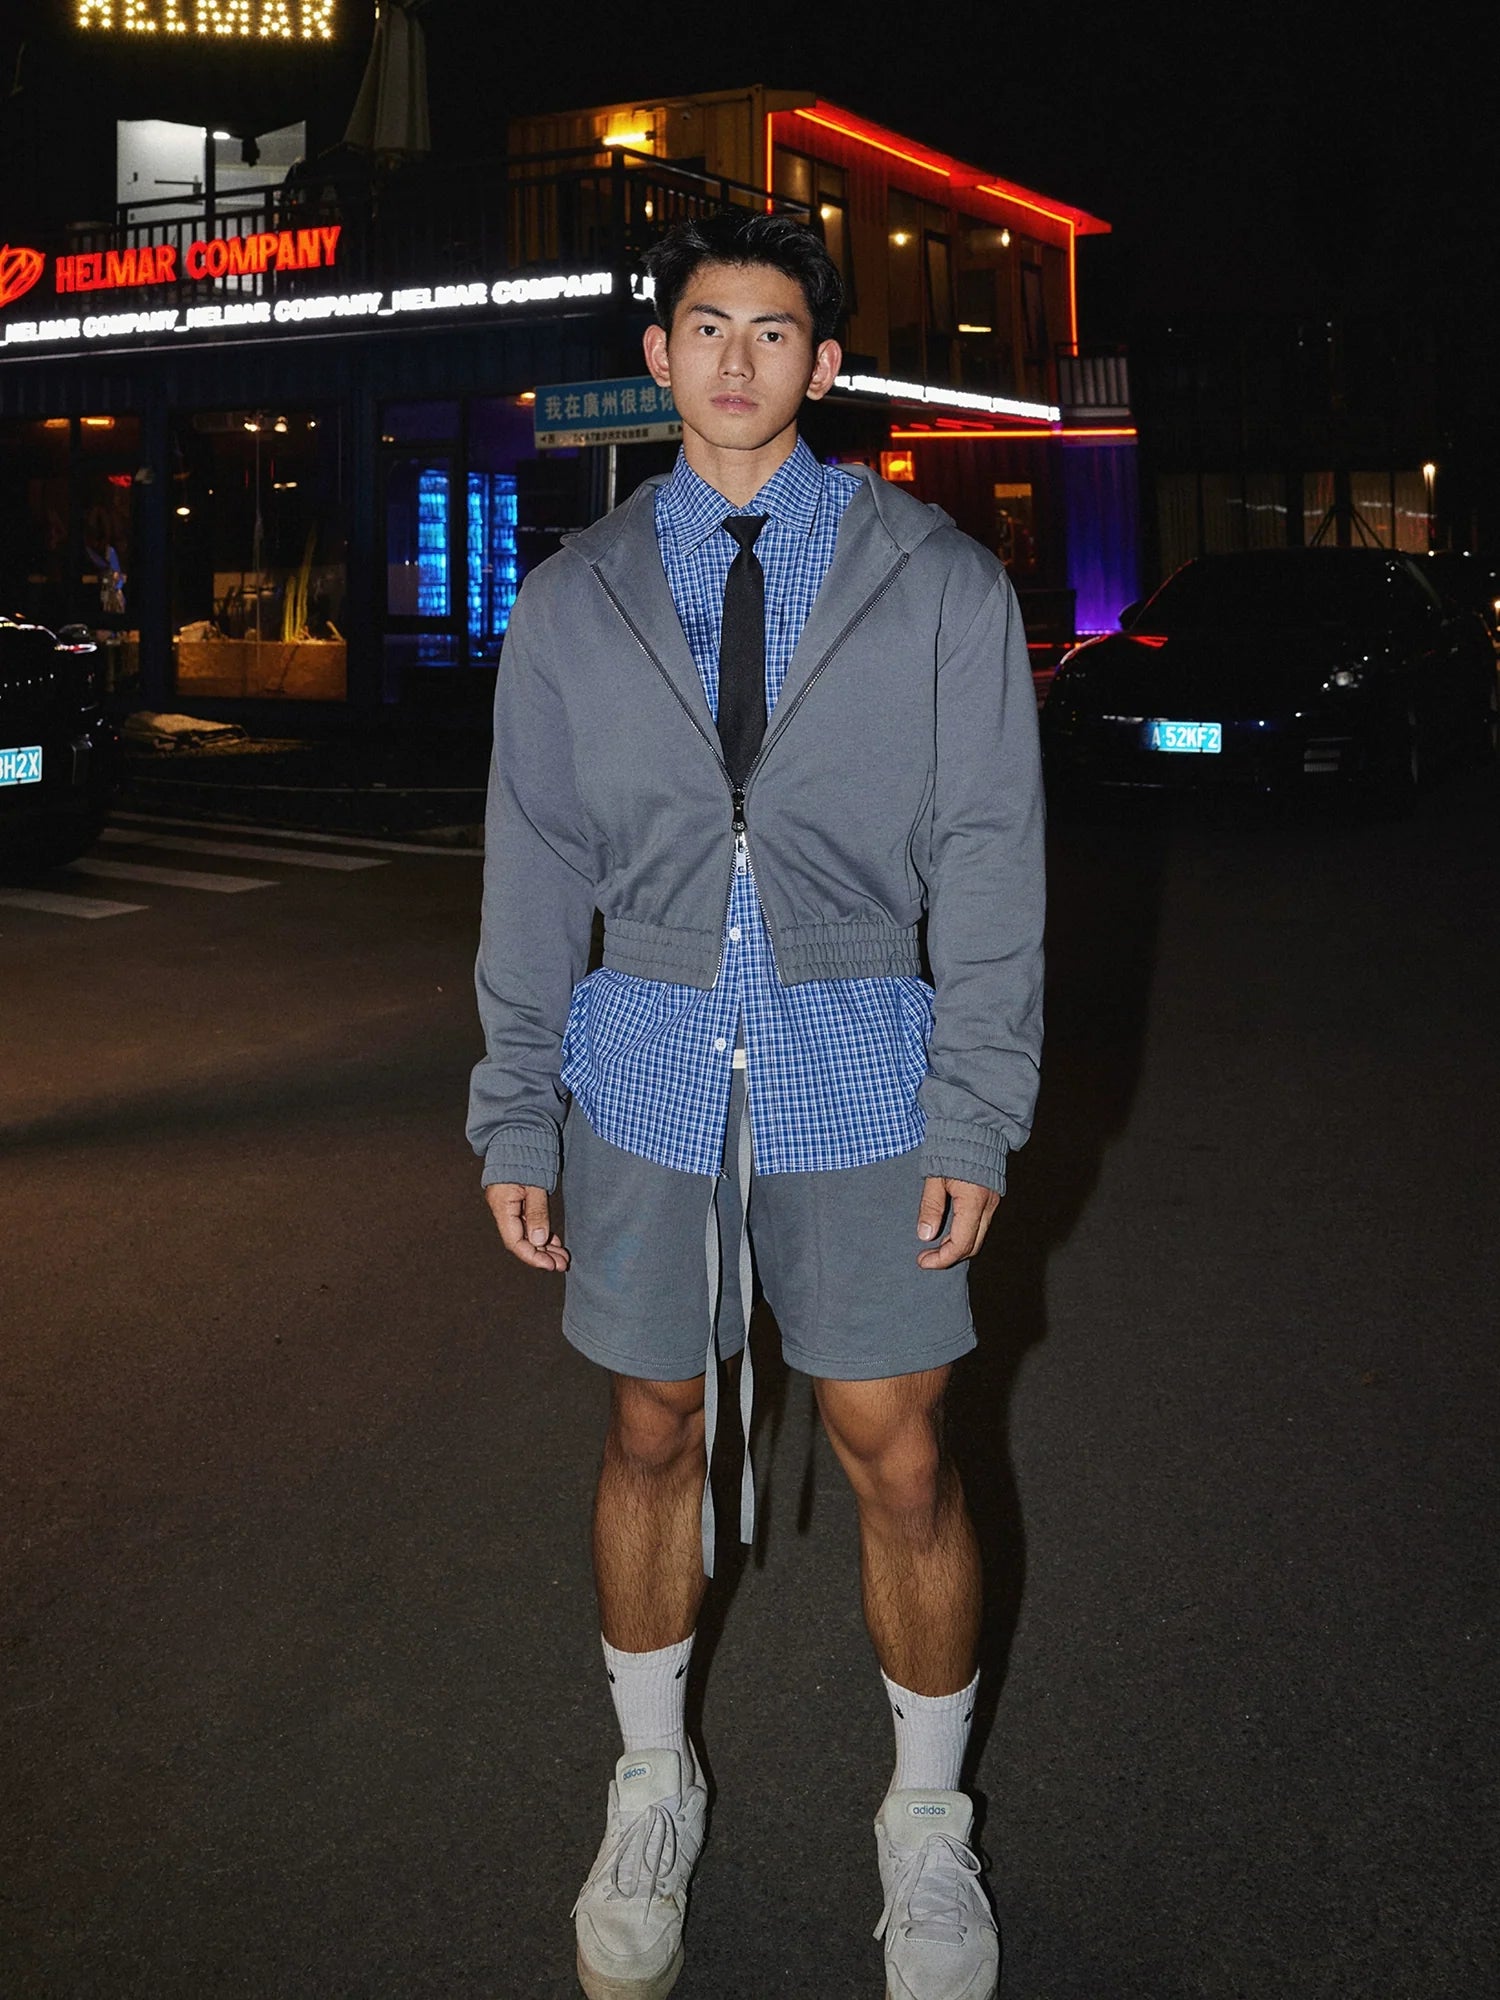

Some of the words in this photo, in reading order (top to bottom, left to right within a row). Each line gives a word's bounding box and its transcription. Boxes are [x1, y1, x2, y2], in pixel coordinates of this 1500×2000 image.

[56, 244, 176, 293] HELMAR
[185, 226, 341, 280] COMPANY
[623, 1766, 647, 1780] adidas
[913, 1805, 947, 1815] adidas
